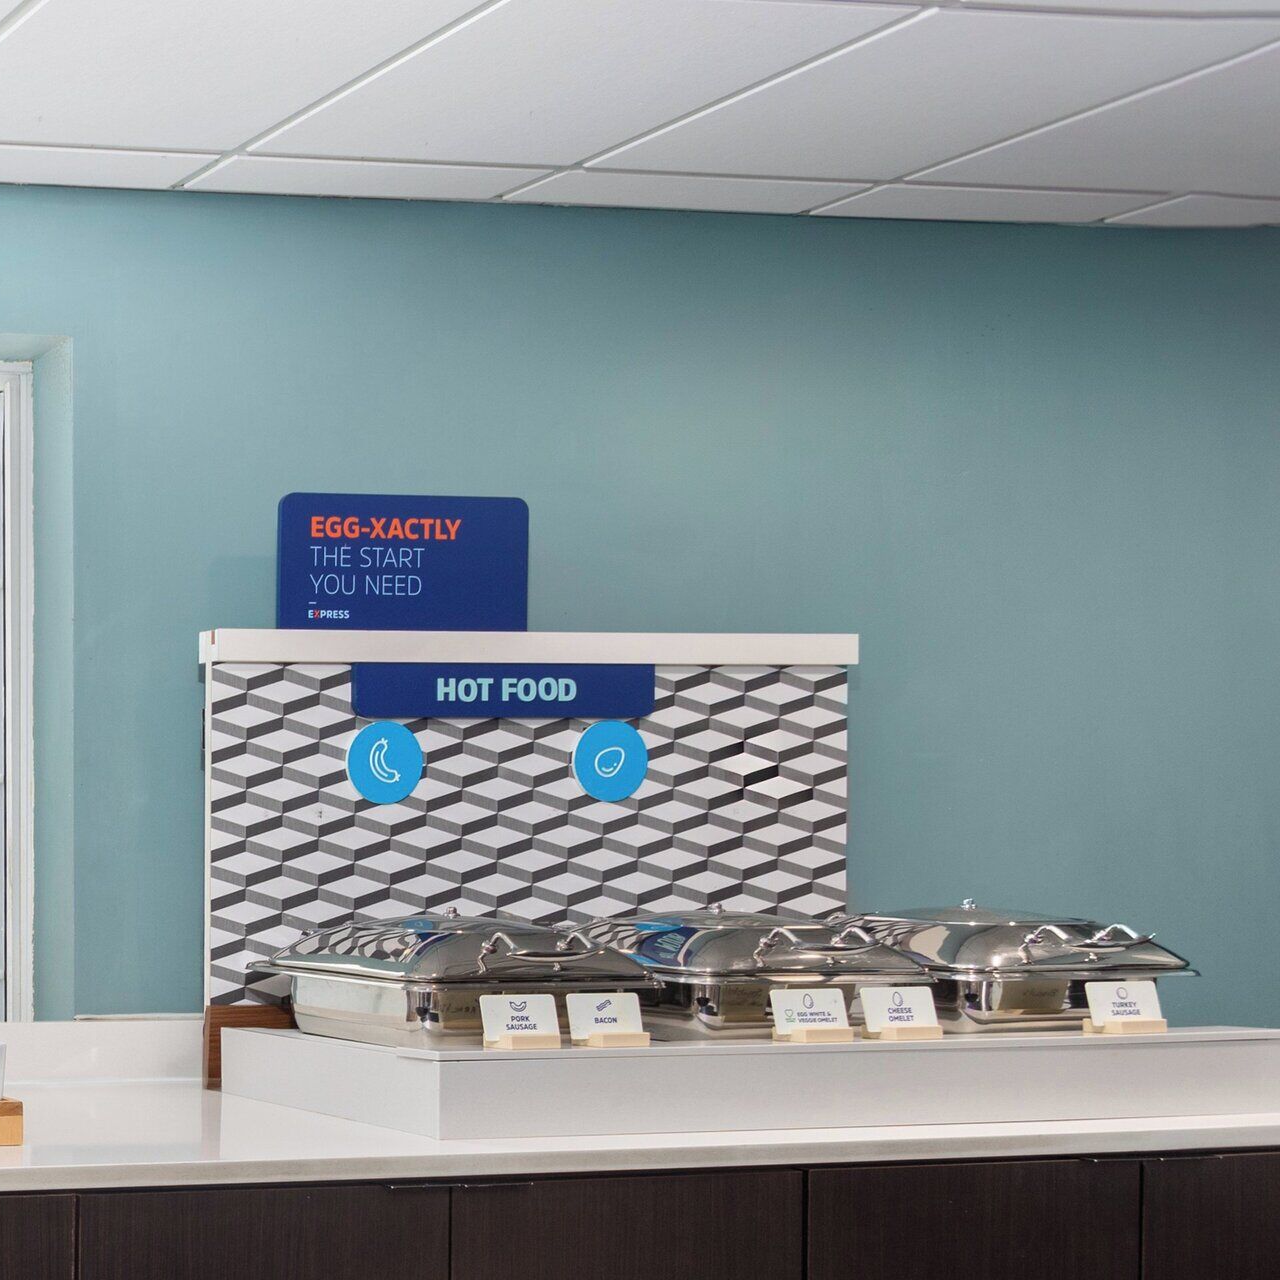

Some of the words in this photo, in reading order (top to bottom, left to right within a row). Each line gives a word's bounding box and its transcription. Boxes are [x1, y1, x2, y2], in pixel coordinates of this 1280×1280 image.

[310, 516, 462, 541] EGG-XACTLY
[310, 545, 352, 568] THE
[359, 546, 425, 569] START
[310, 574, 356, 596] YOU
[365, 575, 422, 597] NEED
[307, 609, 350, 620] EXPRESS
[436, 677, 494, 702] HOT
[502, 677, 577, 702] FOOD
[506, 1023, 538, 1031] SAUSAGE
[510, 1015, 530, 1023] PORK
